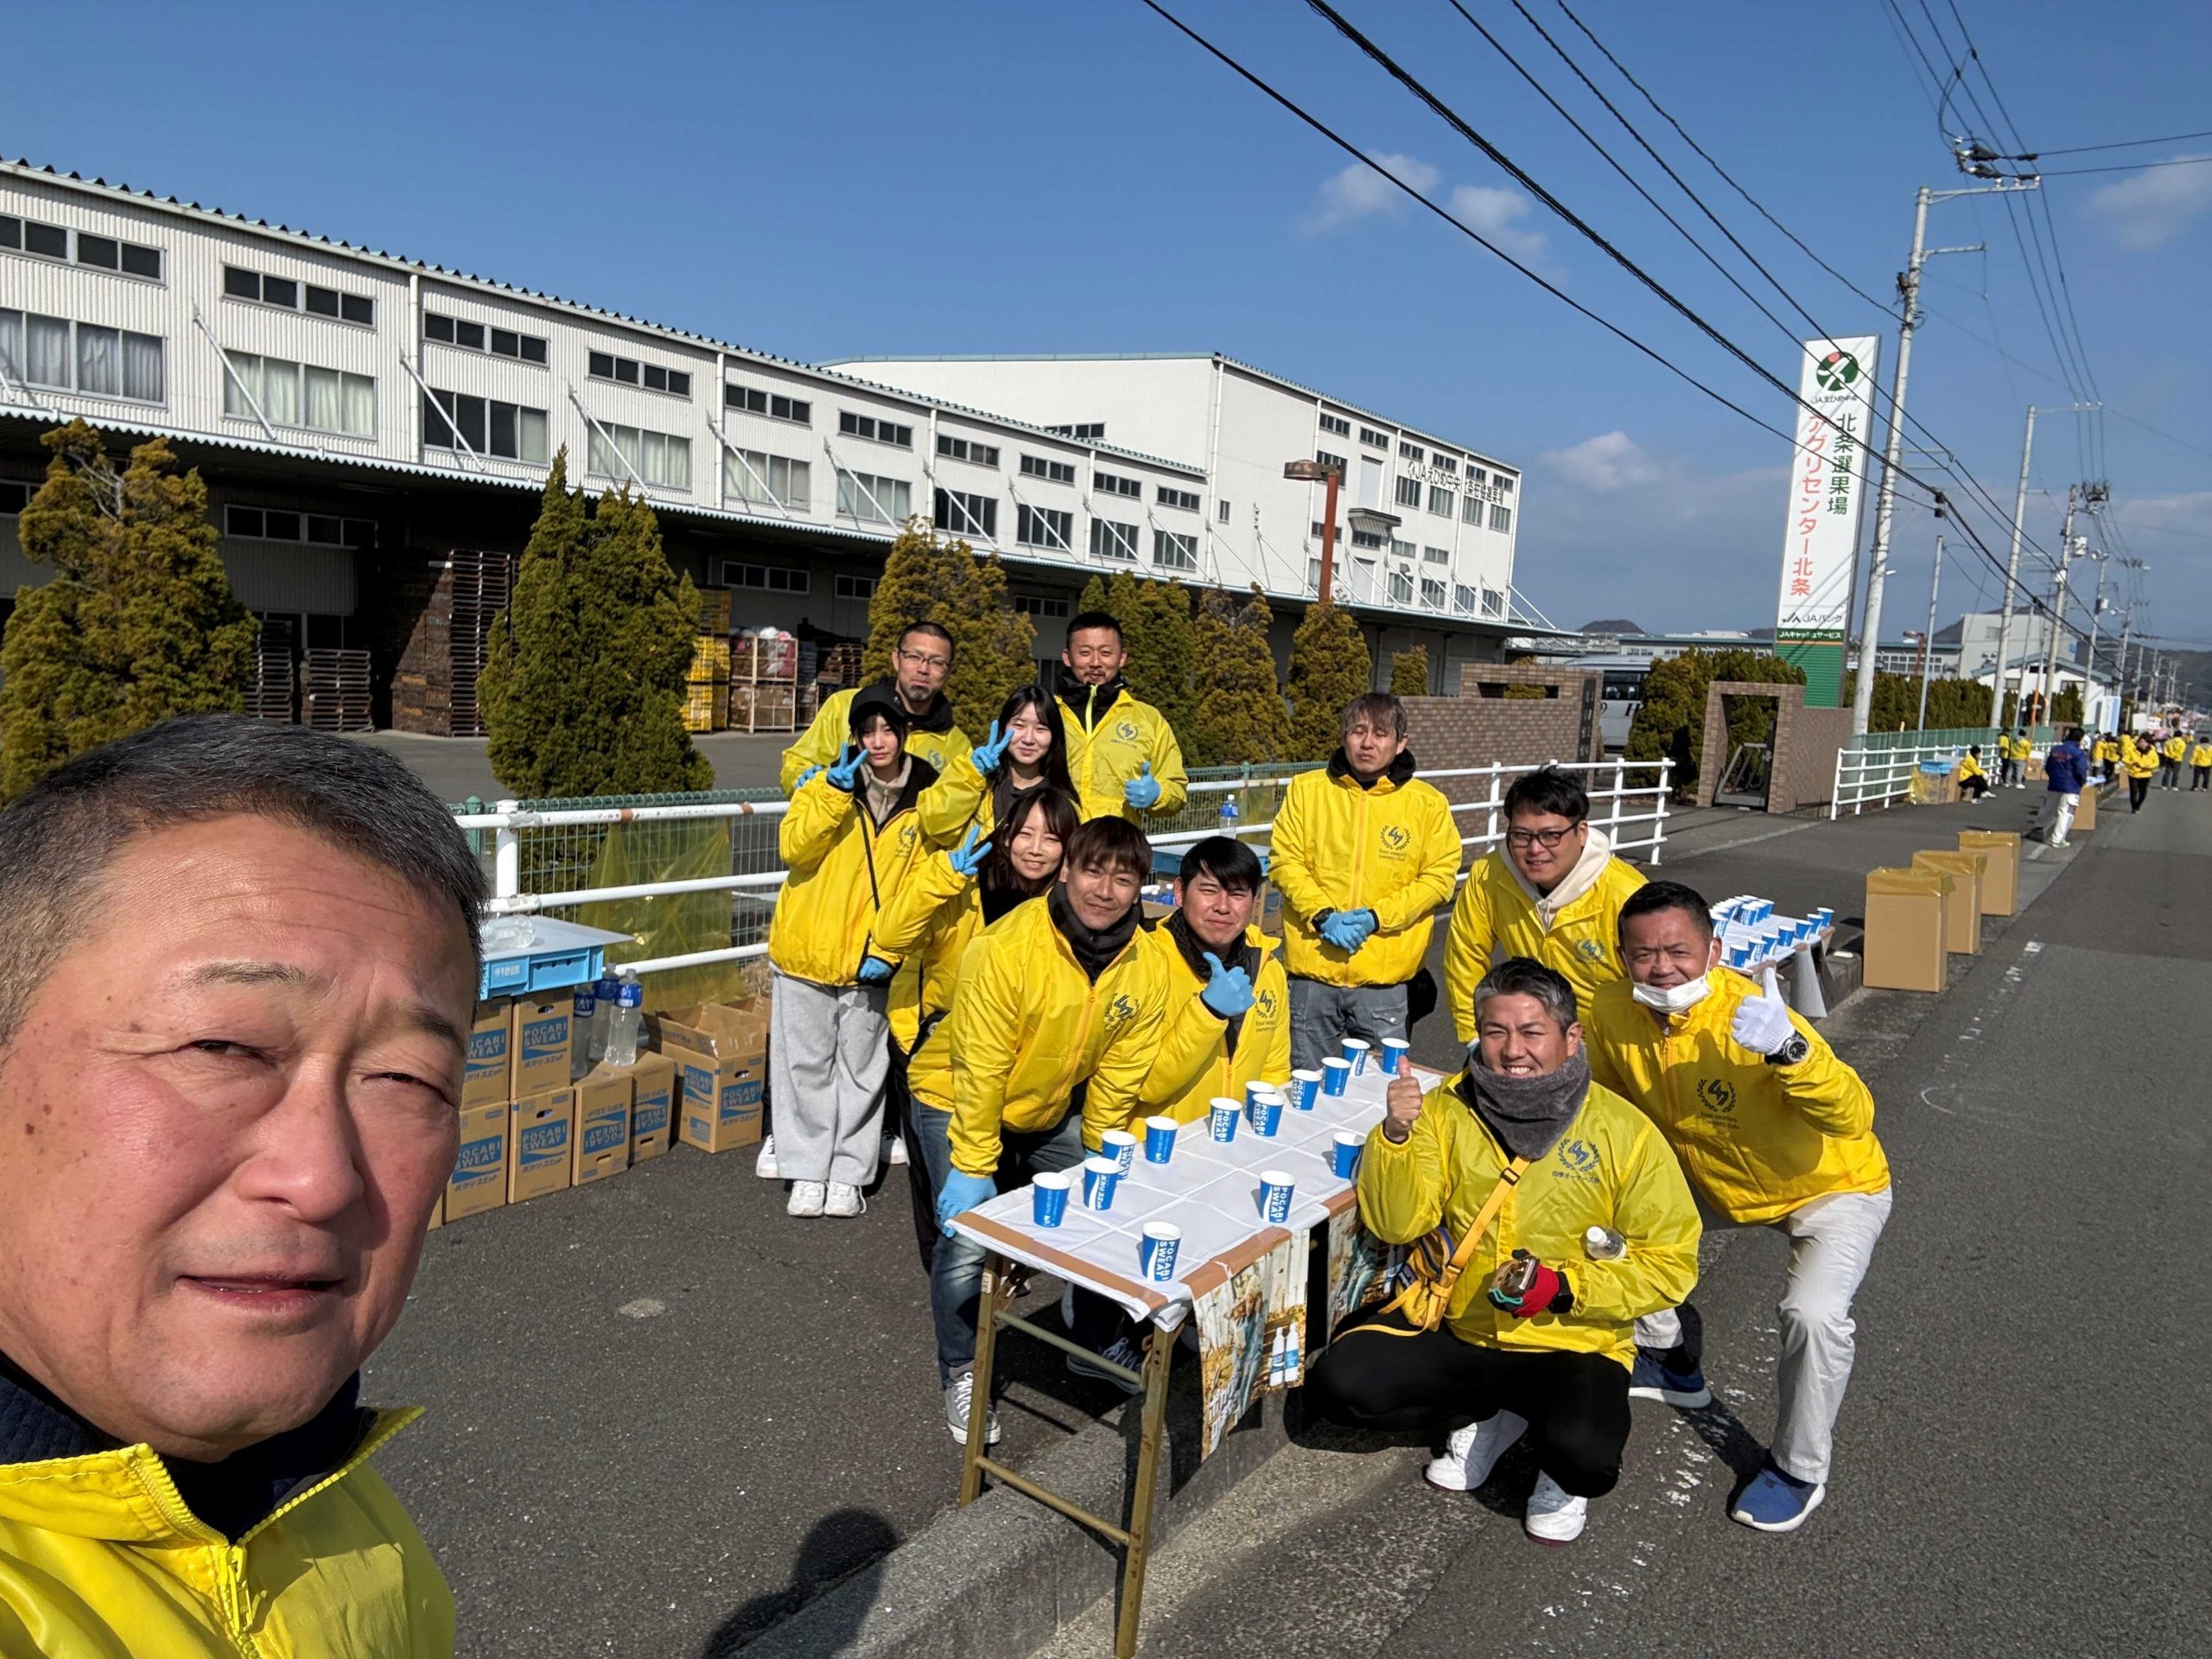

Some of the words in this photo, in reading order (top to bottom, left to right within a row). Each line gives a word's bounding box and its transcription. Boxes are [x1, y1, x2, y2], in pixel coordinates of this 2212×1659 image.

[1827, 412, 1857, 515] 北条選果場
[1790, 414, 1828, 596] アグリセンター北条
[524, 1022, 566, 1038] POCARI
[524, 1033, 561, 1046] SWEAT
[468, 1045, 499, 1058] WEAT
[722, 1094, 756, 1106] SWEAT
[723, 1084, 760, 1098] POCARI
[1215, 1109, 1224, 1139] SWEAT
[1219, 1110, 1230, 1141] POCARI
[1258, 1104, 1268, 1135] POCARI
[523, 1125, 566, 1142] POCARI
[590, 1123, 624, 1138] SWEAT
[522, 1135, 561, 1153] SWEAT
[585, 1132, 624, 1148] POCARI
[455, 1152, 495, 1170] SWEAT
[1270, 1185, 1281, 1219] SWEAT
[1275, 1186, 1288, 1223] POCARI
[1155, 1241, 1167, 1278] SWEAT
[1161, 1241, 1176, 1281] POCARI
